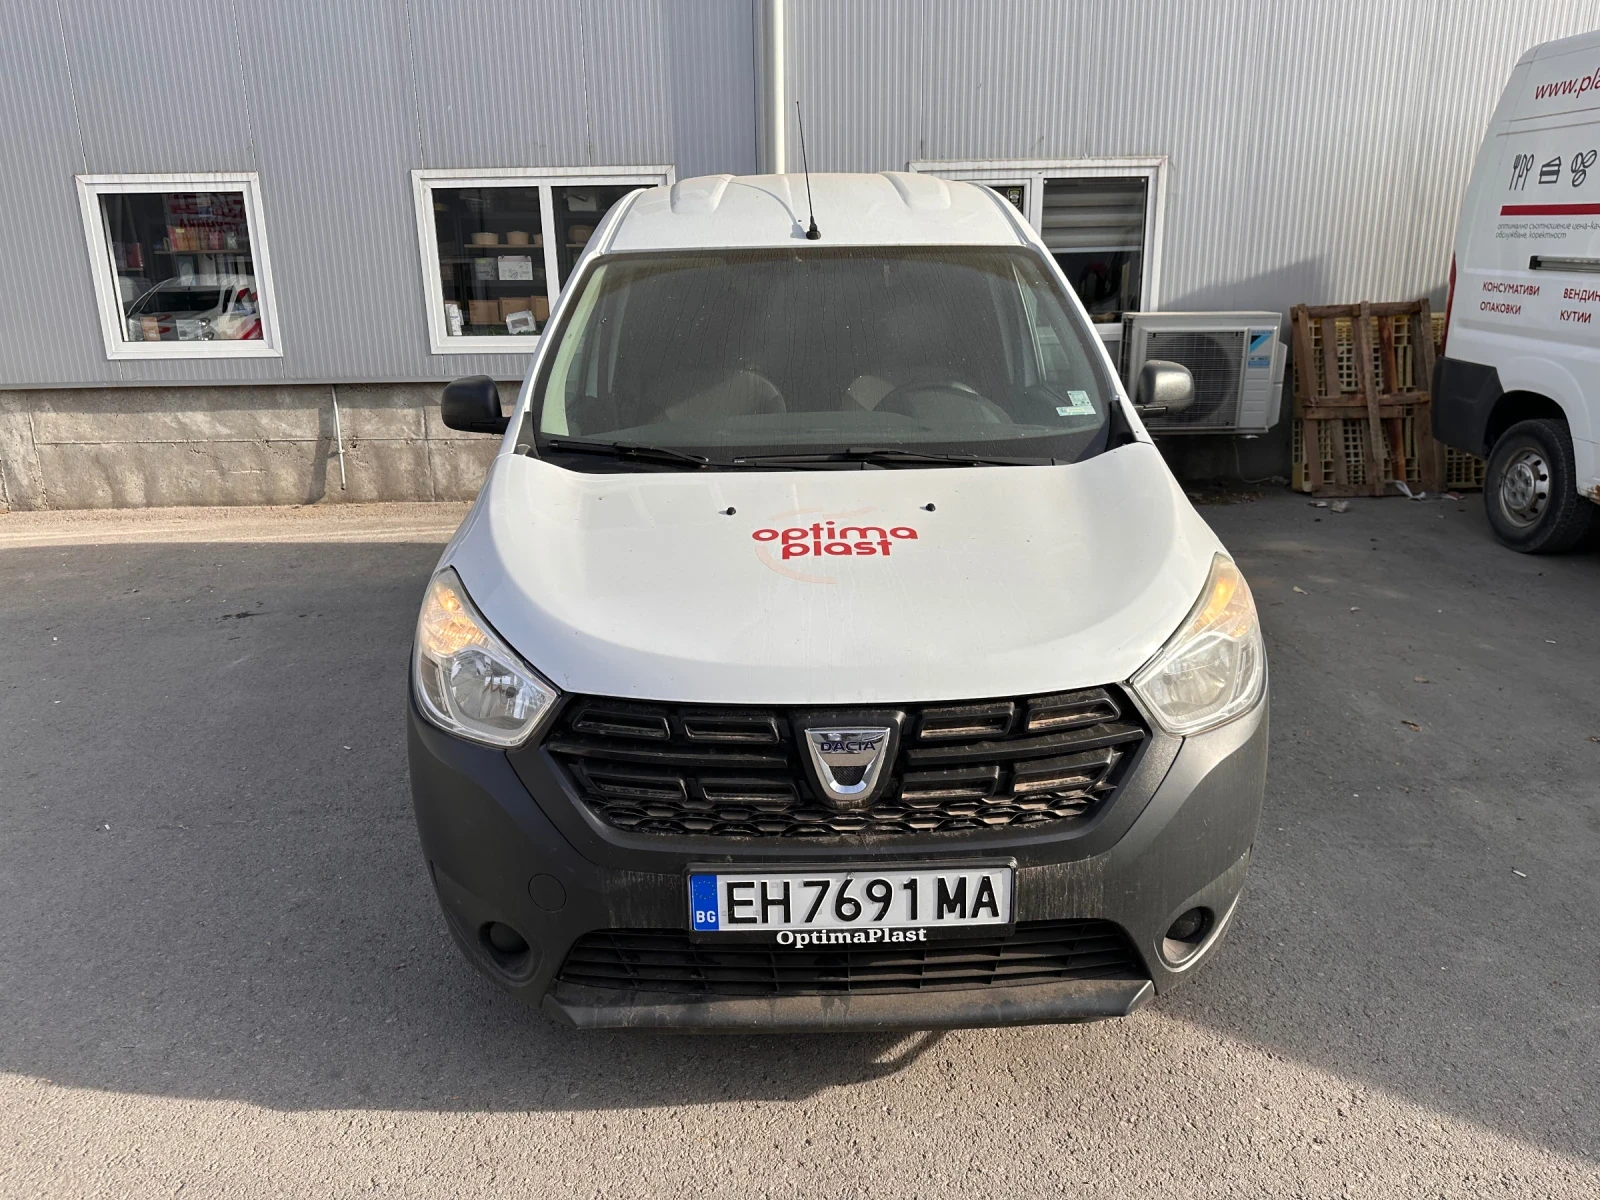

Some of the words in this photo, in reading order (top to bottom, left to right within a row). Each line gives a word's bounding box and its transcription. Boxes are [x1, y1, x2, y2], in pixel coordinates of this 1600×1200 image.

[1482, 281, 1540, 296] КОНСУМАТИВИ
[1563, 287, 1600, 303] ВЕНДИН
[1480, 301, 1522, 315] ОПАКОВКИ
[1560, 309, 1592, 324] КУТИИ
[752, 521, 918, 545] optima
[782, 539, 892, 560] plast
[820, 740, 876, 752] DACIA
[696, 910, 716, 923] BG
[776, 927, 927, 948] OptimaPlast
